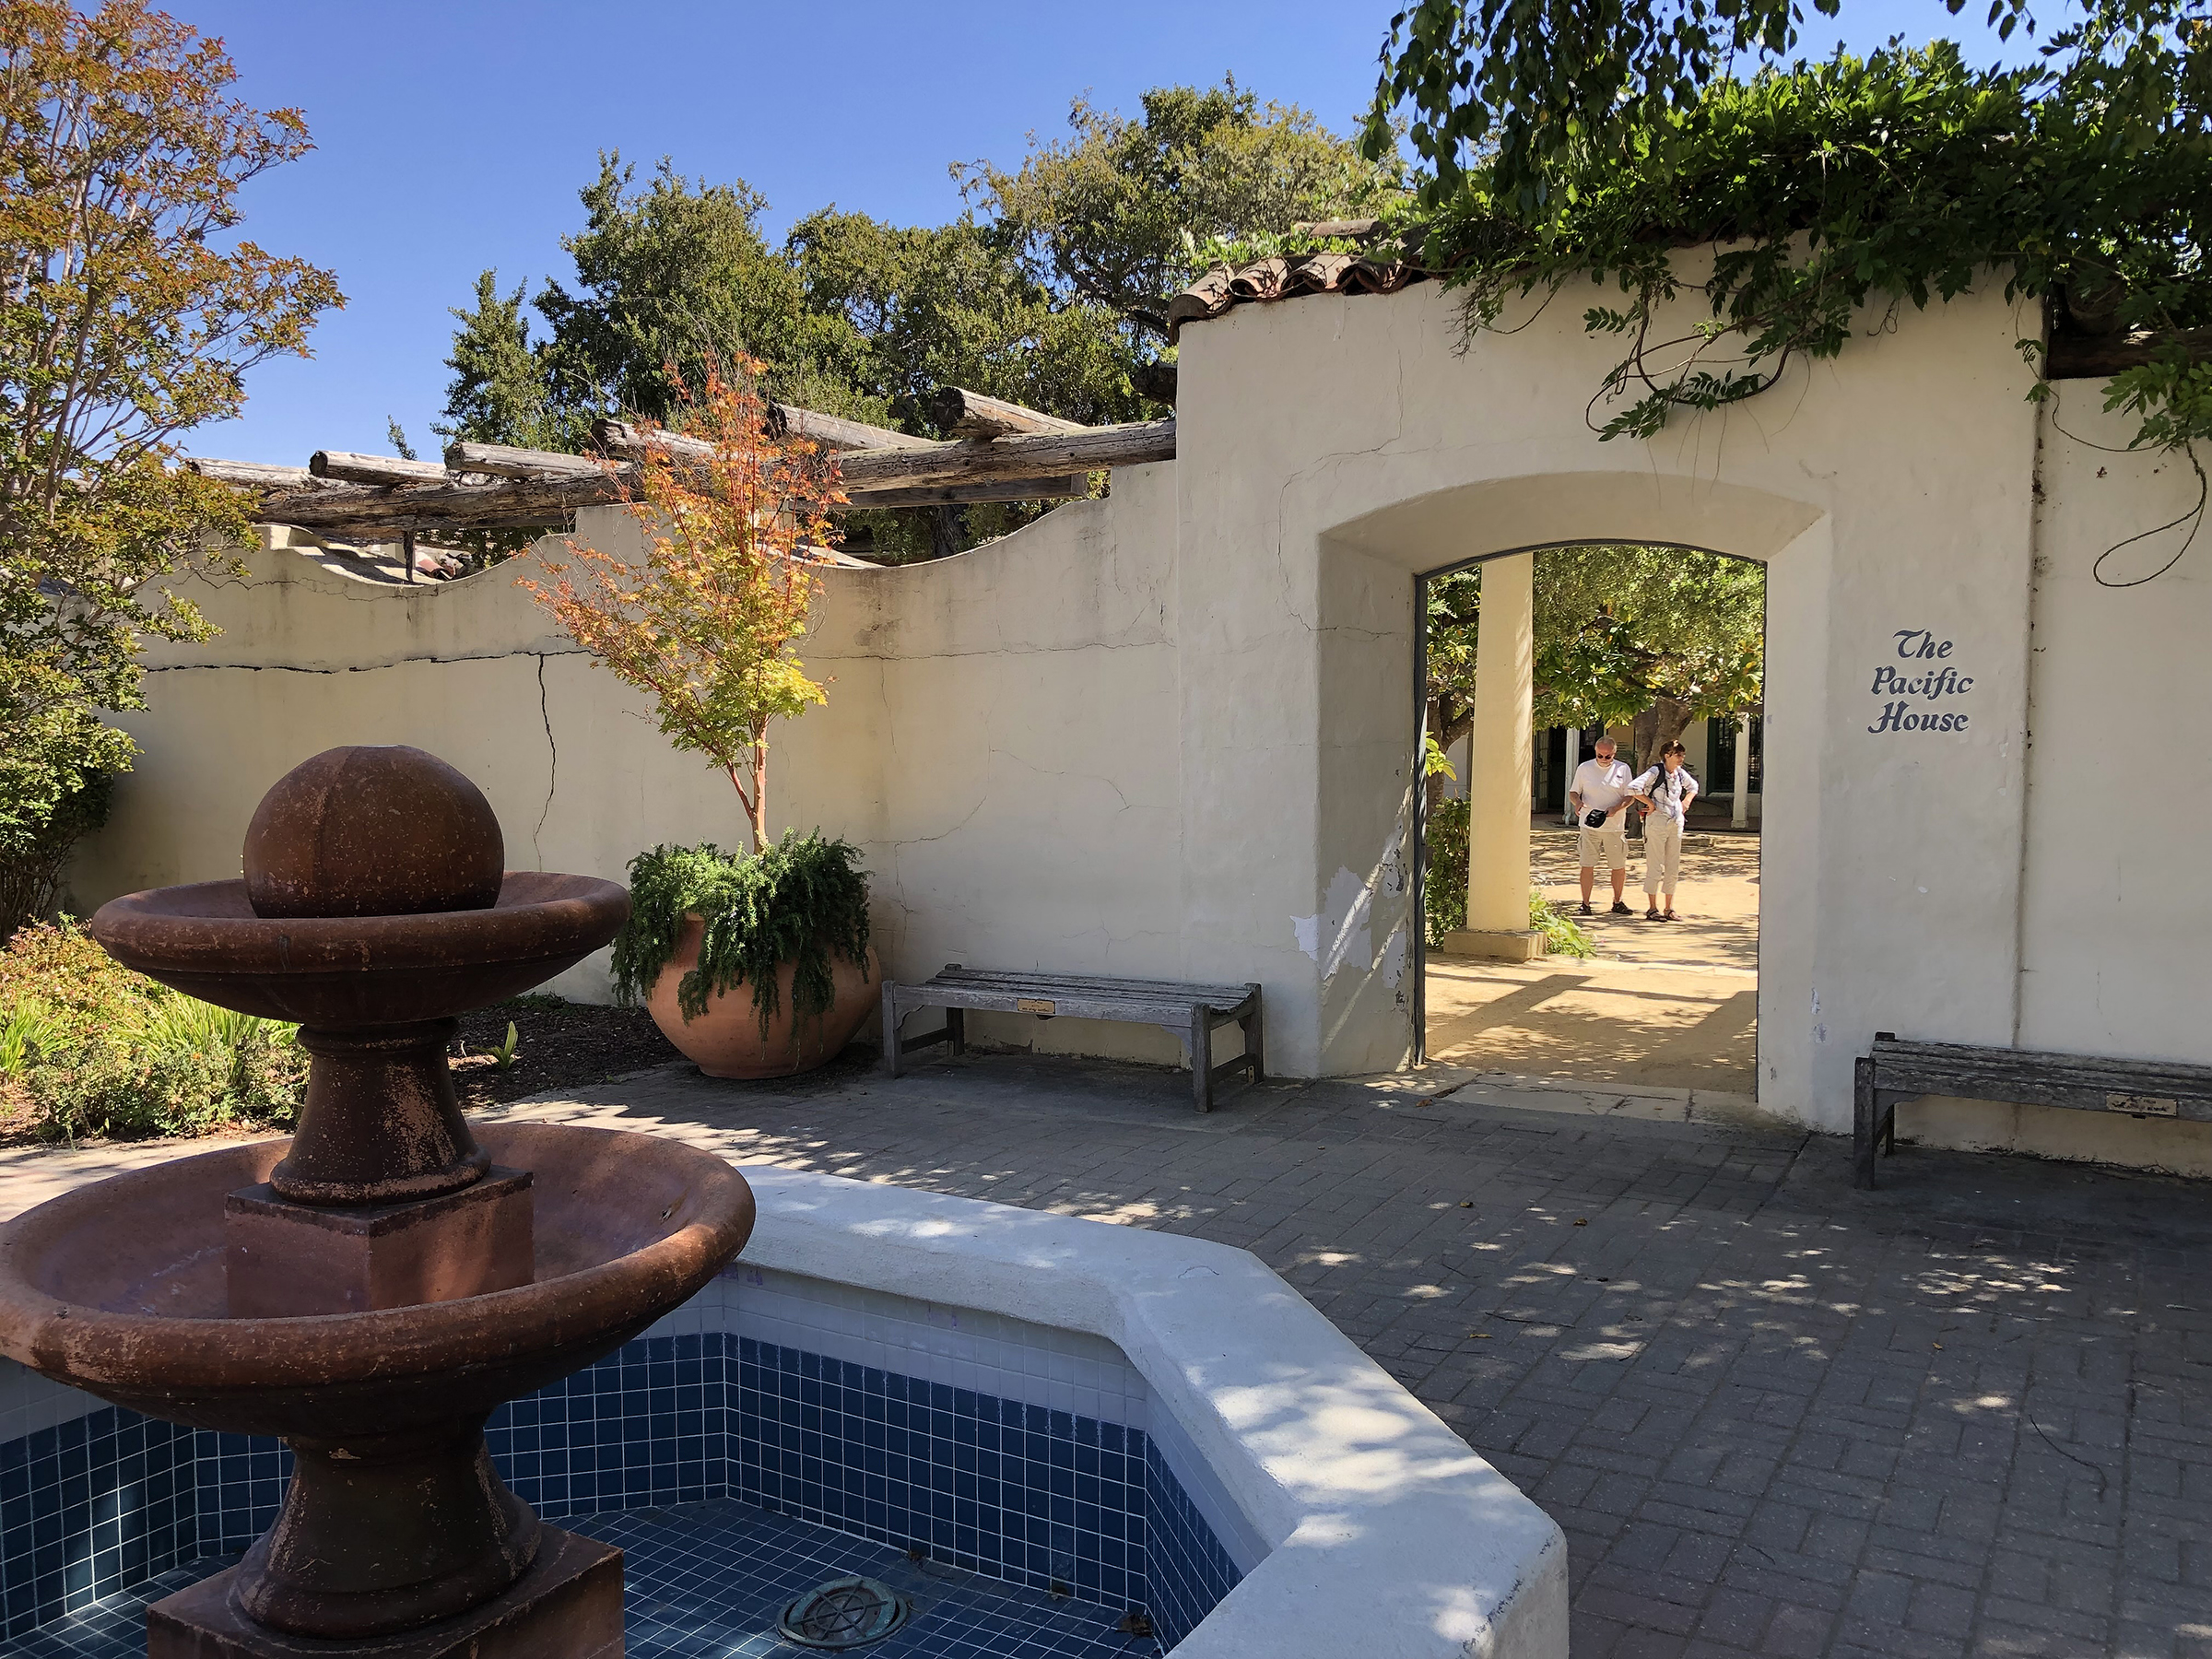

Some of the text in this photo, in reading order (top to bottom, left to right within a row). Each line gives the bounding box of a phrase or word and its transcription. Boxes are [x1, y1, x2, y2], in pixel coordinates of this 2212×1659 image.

[1892, 629, 1953, 659] The
[1870, 665, 1974, 700] Pacific
[1867, 700, 1969, 734] House
